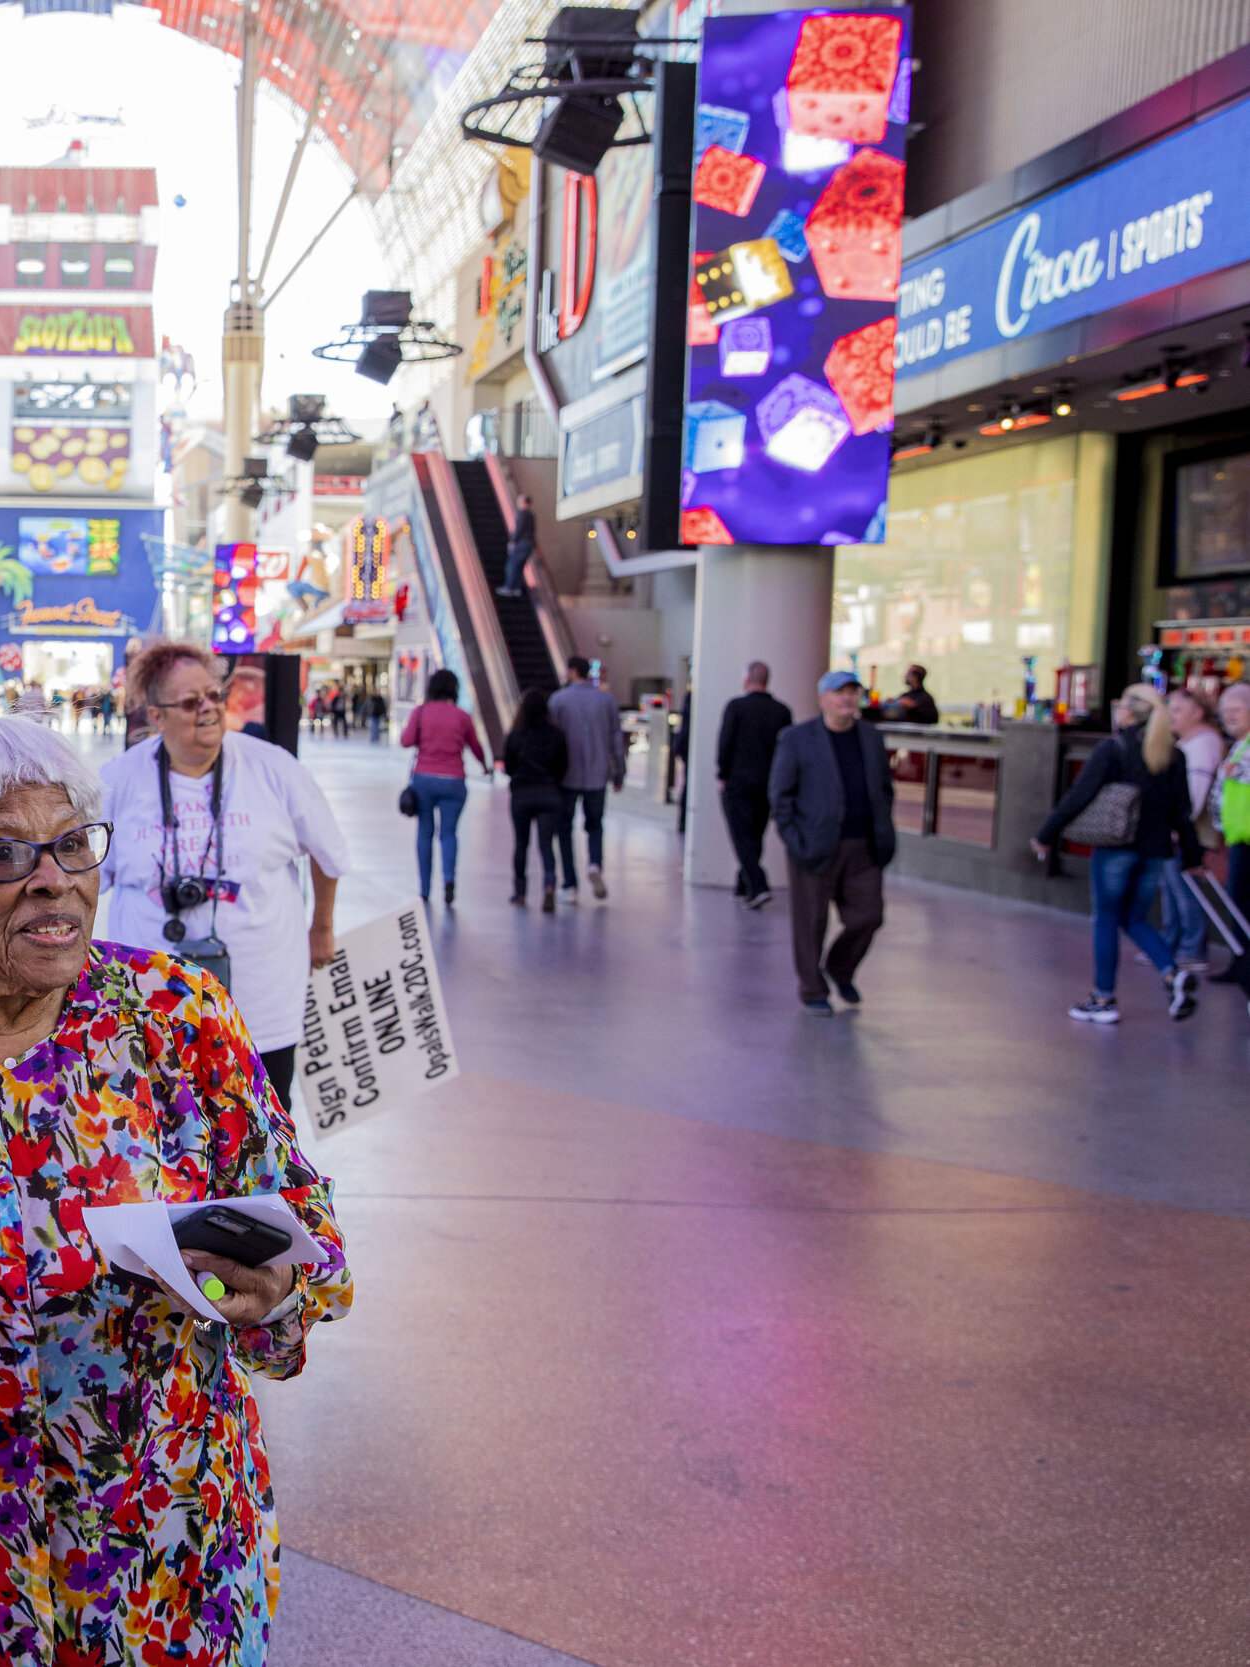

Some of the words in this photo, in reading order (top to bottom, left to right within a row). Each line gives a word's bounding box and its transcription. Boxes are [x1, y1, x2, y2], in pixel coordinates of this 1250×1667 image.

[995, 211, 1105, 338] Circa
[1120, 192, 1204, 275] SPORTS
[943, 304, 972, 351] BE
[363, 969, 406, 1055] ONLINE
[318, 1076, 347, 1130] Sign
[341, 1015, 380, 1108] Confirm
